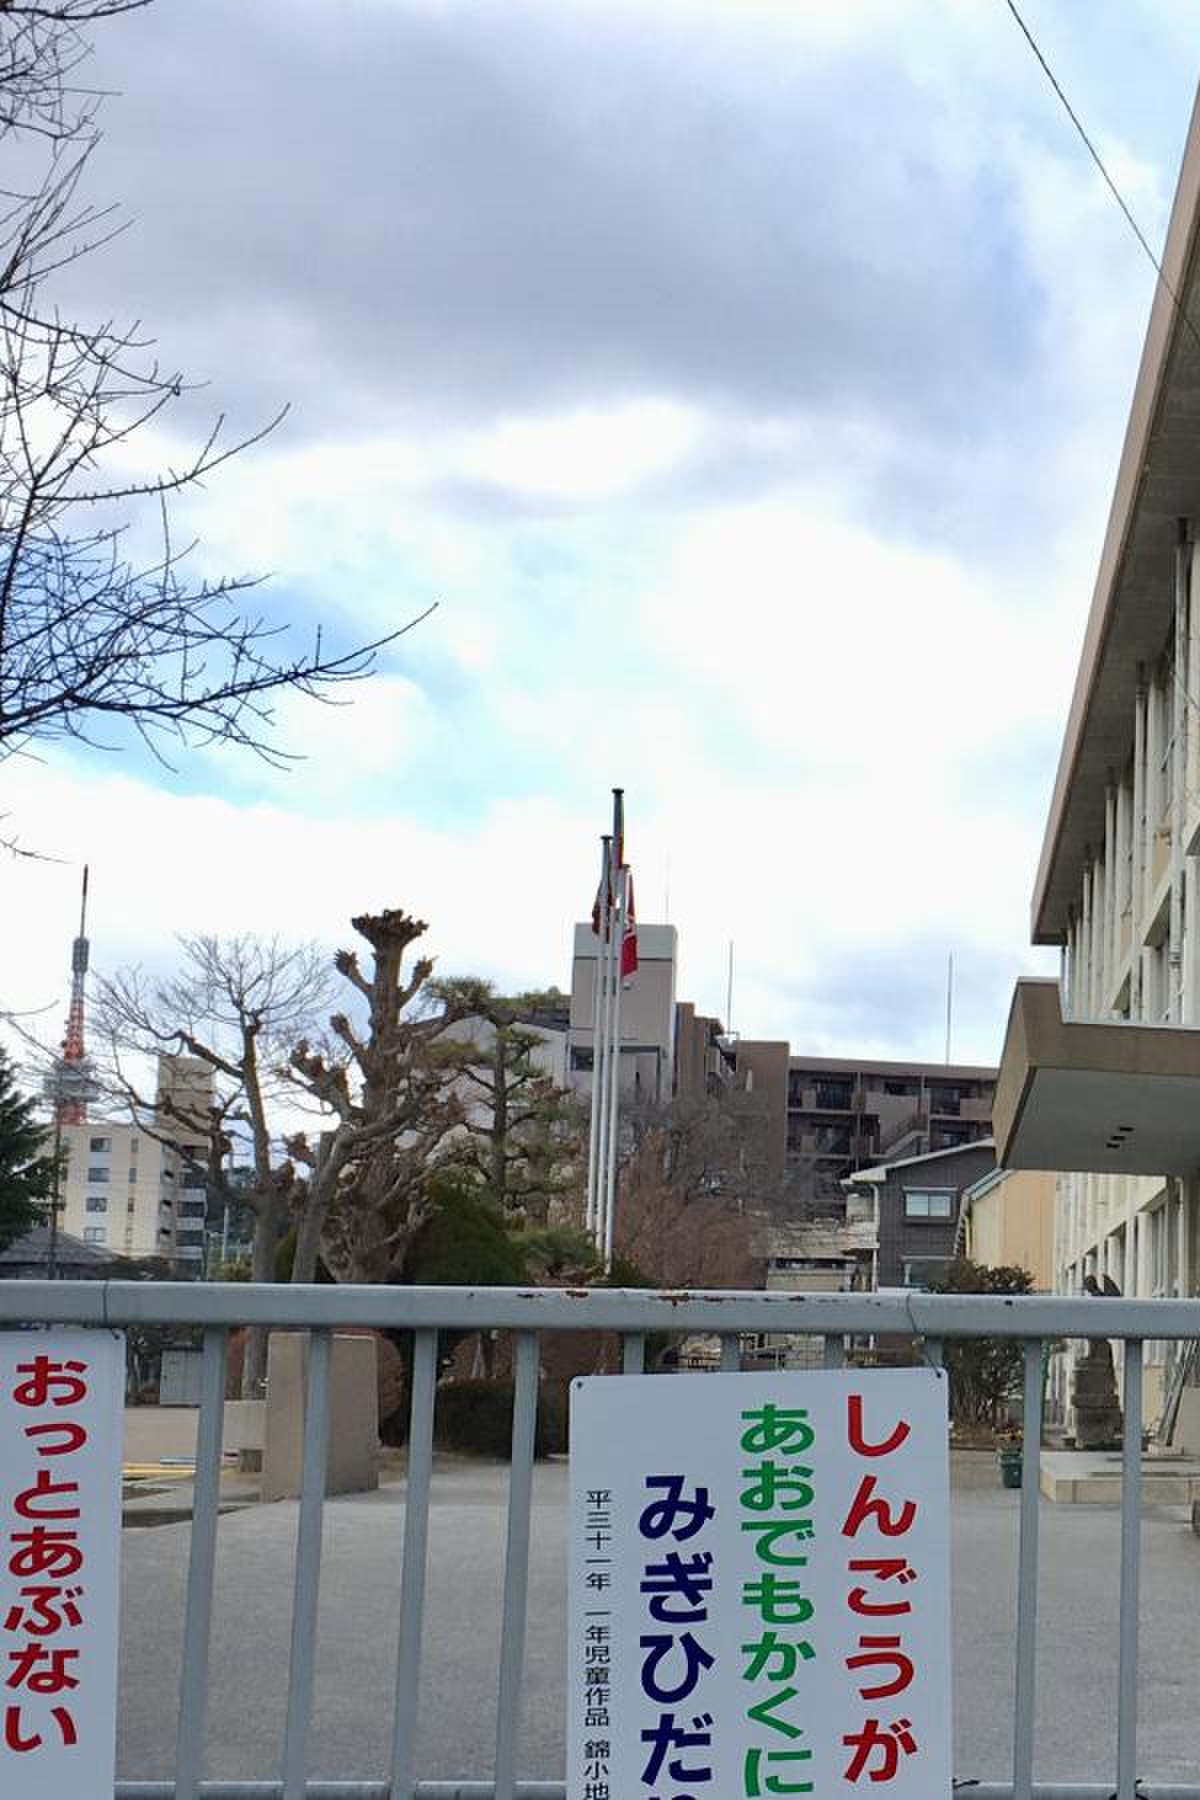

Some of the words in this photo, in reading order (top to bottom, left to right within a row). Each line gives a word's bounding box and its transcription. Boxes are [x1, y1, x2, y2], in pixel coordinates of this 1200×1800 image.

[3, 1356, 87, 1751] おっとあぶない
[584, 1611, 610, 1727] 一年児童作品
[585, 1490, 611, 1591] 平三十一年
[639, 1475, 715, 1800] みぎひだ
[740, 1404, 816, 1798] あおでもかくに
[842, 1395, 917, 1783] しんごうが
